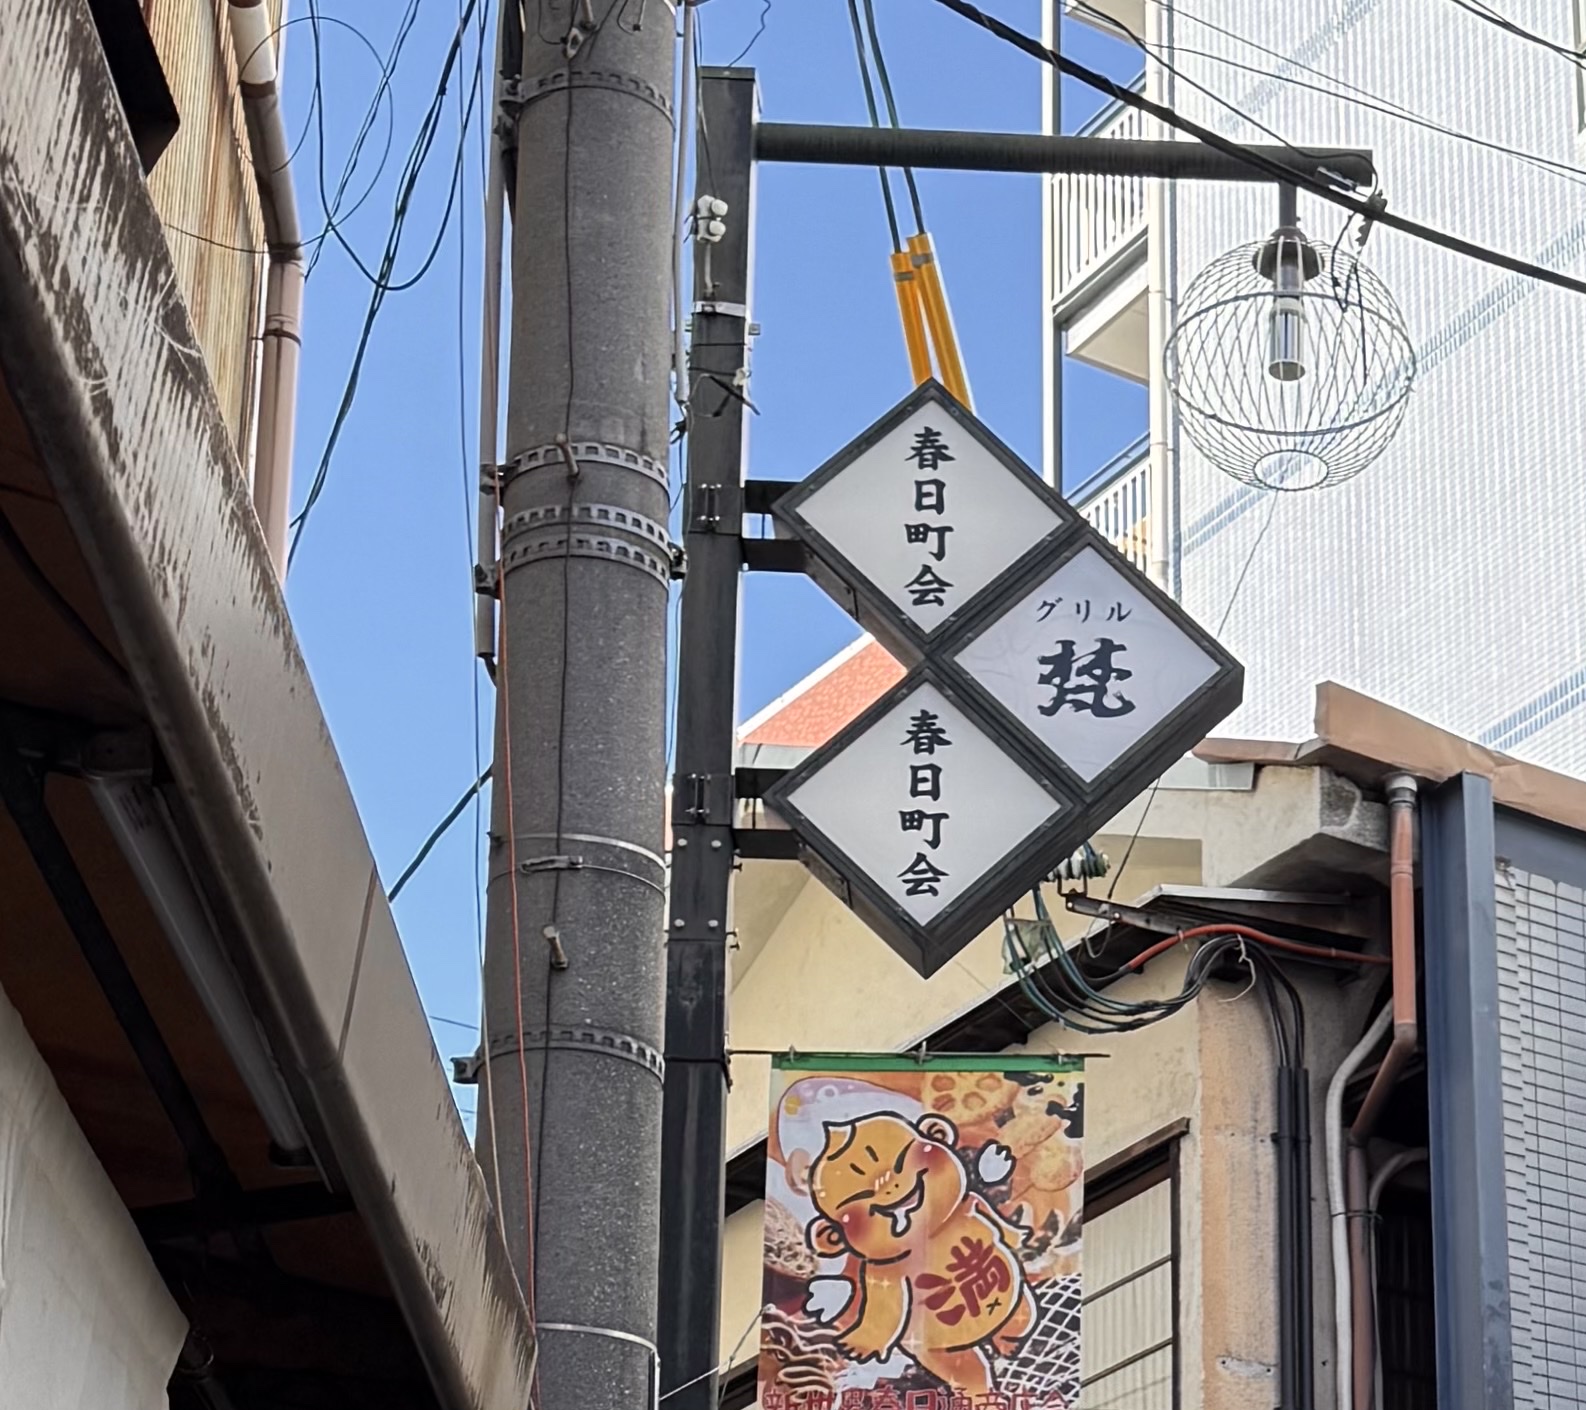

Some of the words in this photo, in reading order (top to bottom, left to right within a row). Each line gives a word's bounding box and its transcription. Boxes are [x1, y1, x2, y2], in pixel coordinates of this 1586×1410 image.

[904, 425, 956, 608] 春日町会
[1036, 597, 1134, 625] グリル
[897, 708, 953, 897] 春日町会
[914, 1235, 1012, 1328] 満
